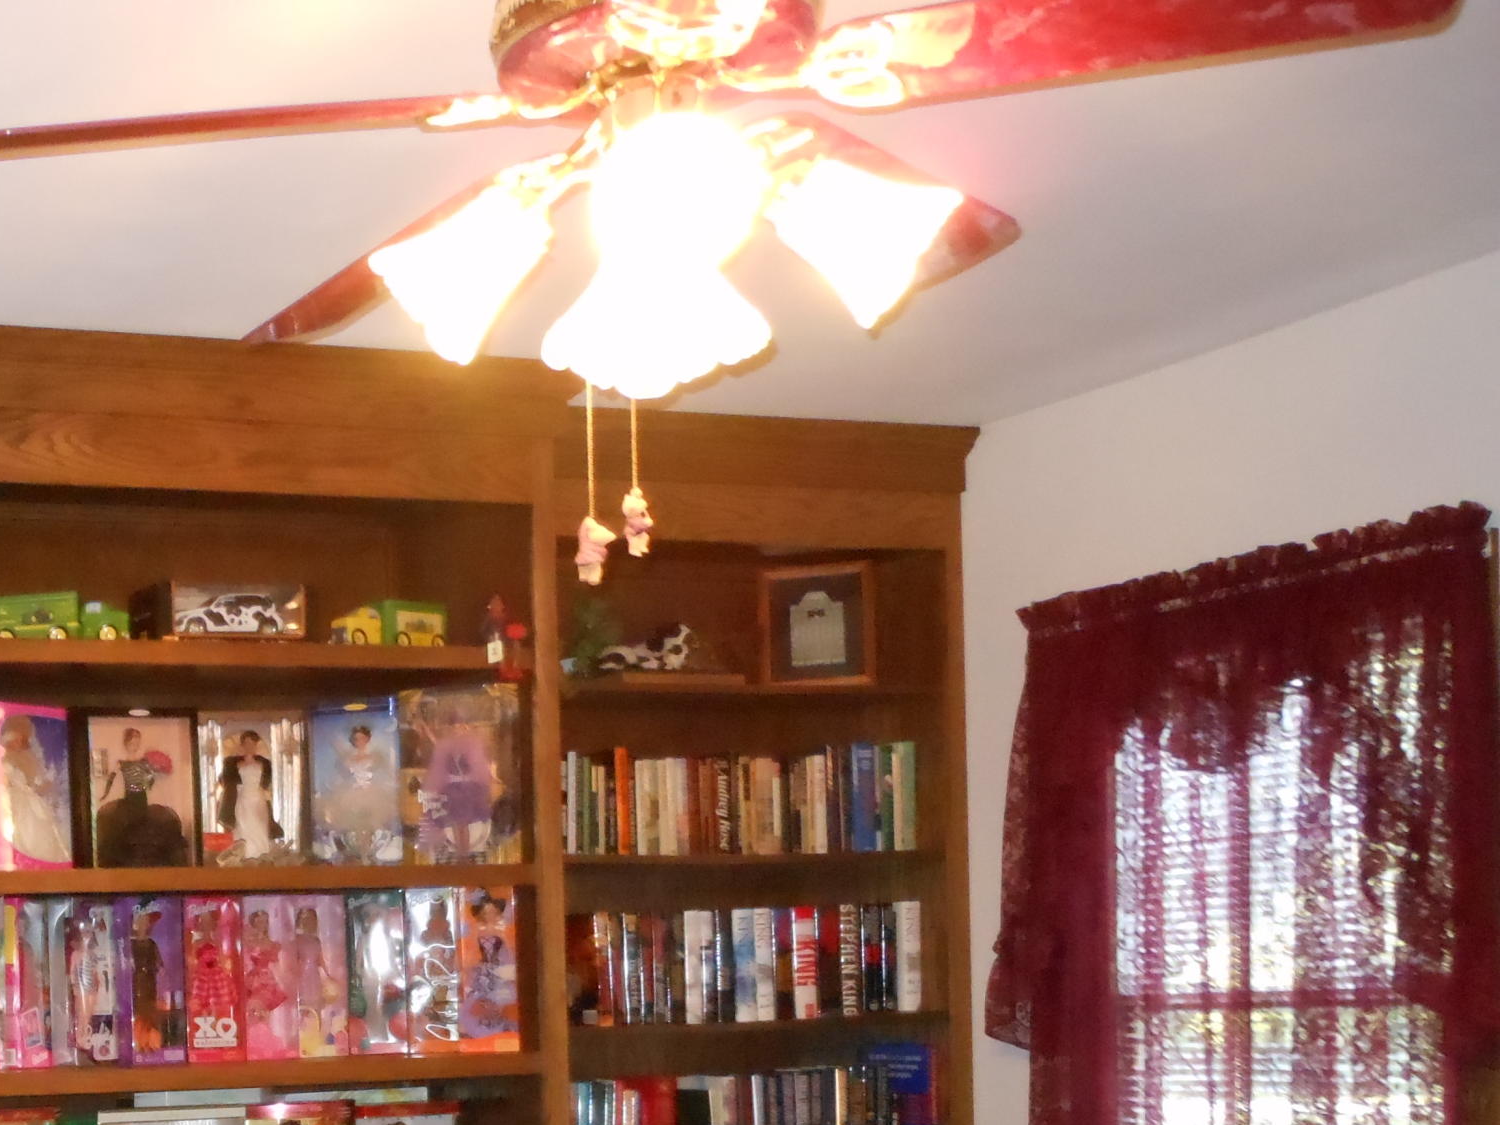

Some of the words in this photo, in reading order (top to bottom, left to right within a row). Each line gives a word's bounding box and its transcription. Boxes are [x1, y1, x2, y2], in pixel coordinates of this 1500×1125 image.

[719, 821, 731, 851] Rose
[840, 904, 858, 975] STEPHEN
[795, 940, 817, 986] KING
[841, 979, 859, 1016] KING
